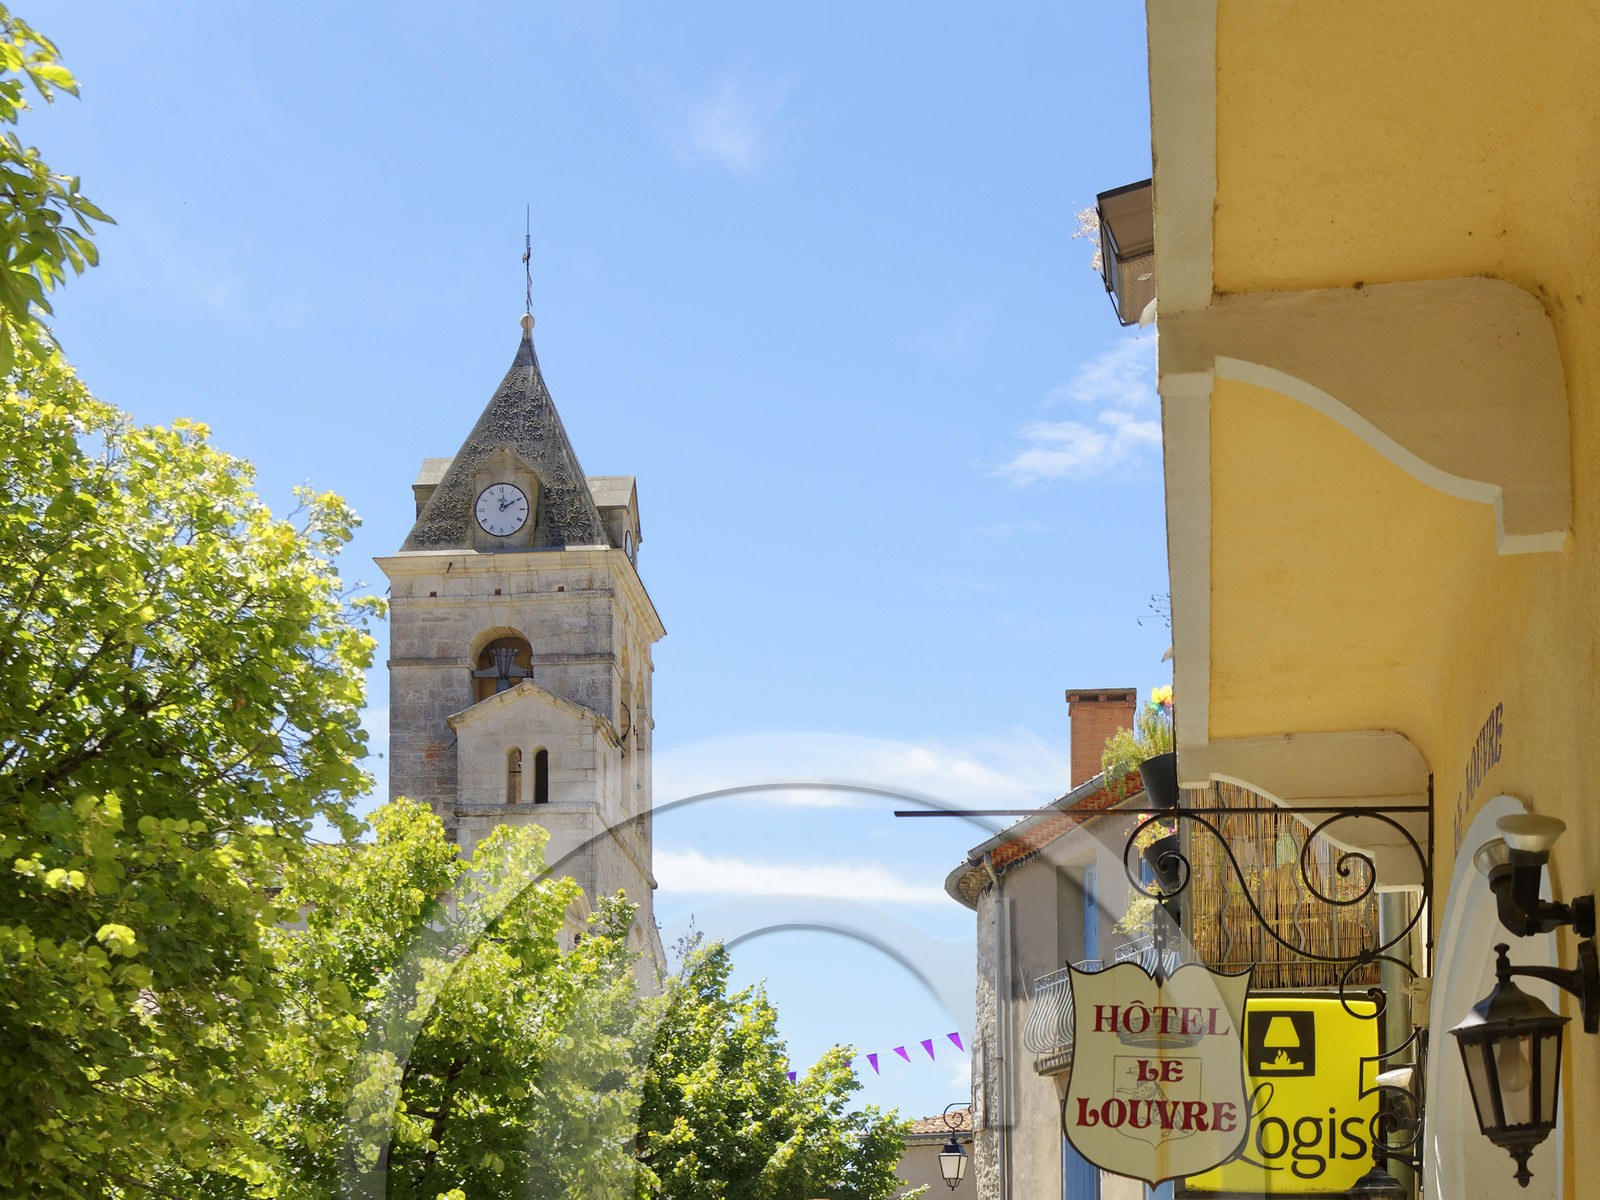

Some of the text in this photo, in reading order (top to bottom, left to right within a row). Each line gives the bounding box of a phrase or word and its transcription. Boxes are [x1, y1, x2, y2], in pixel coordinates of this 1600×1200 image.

[1466, 702, 1503, 813] LOUVRE
[1092, 1000, 1230, 1035] HÔTEL
[1137, 1060, 1184, 1082] LE
[1076, 1097, 1237, 1132] LOUVRE
[1223, 1082, 1367, 1179] Logis
